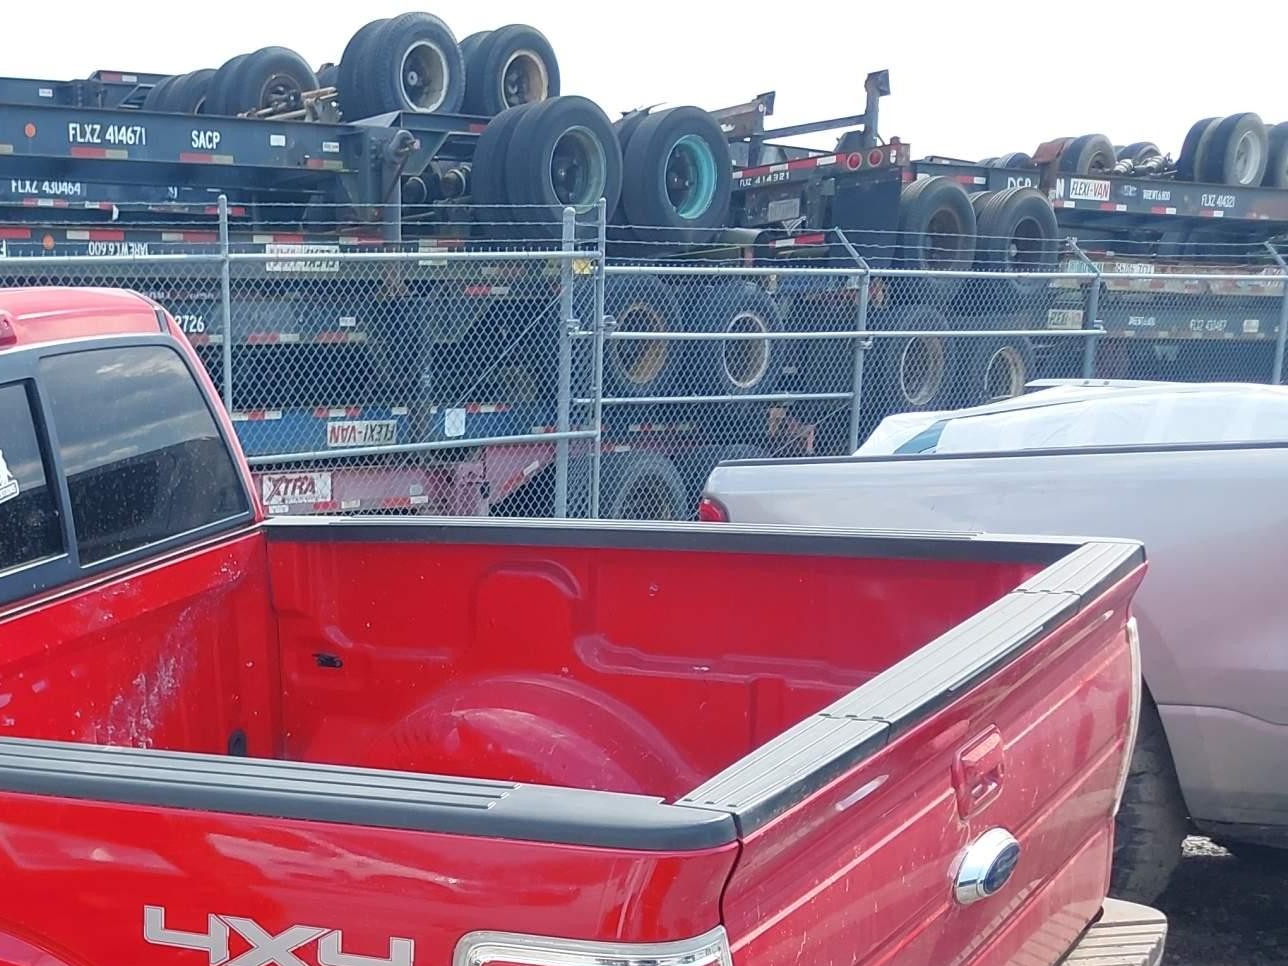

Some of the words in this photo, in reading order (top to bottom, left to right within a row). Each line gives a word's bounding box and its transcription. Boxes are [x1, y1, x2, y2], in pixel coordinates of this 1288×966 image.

[69, 123, 102, 143] FLXZ
[105, 125, 146, 145] 414671
[191, 130, 220, 150] SACP
[1072, 180, 1109, 200] FLEXI-VAN
[329, 424, 396, 444] FLEXI-VAN
